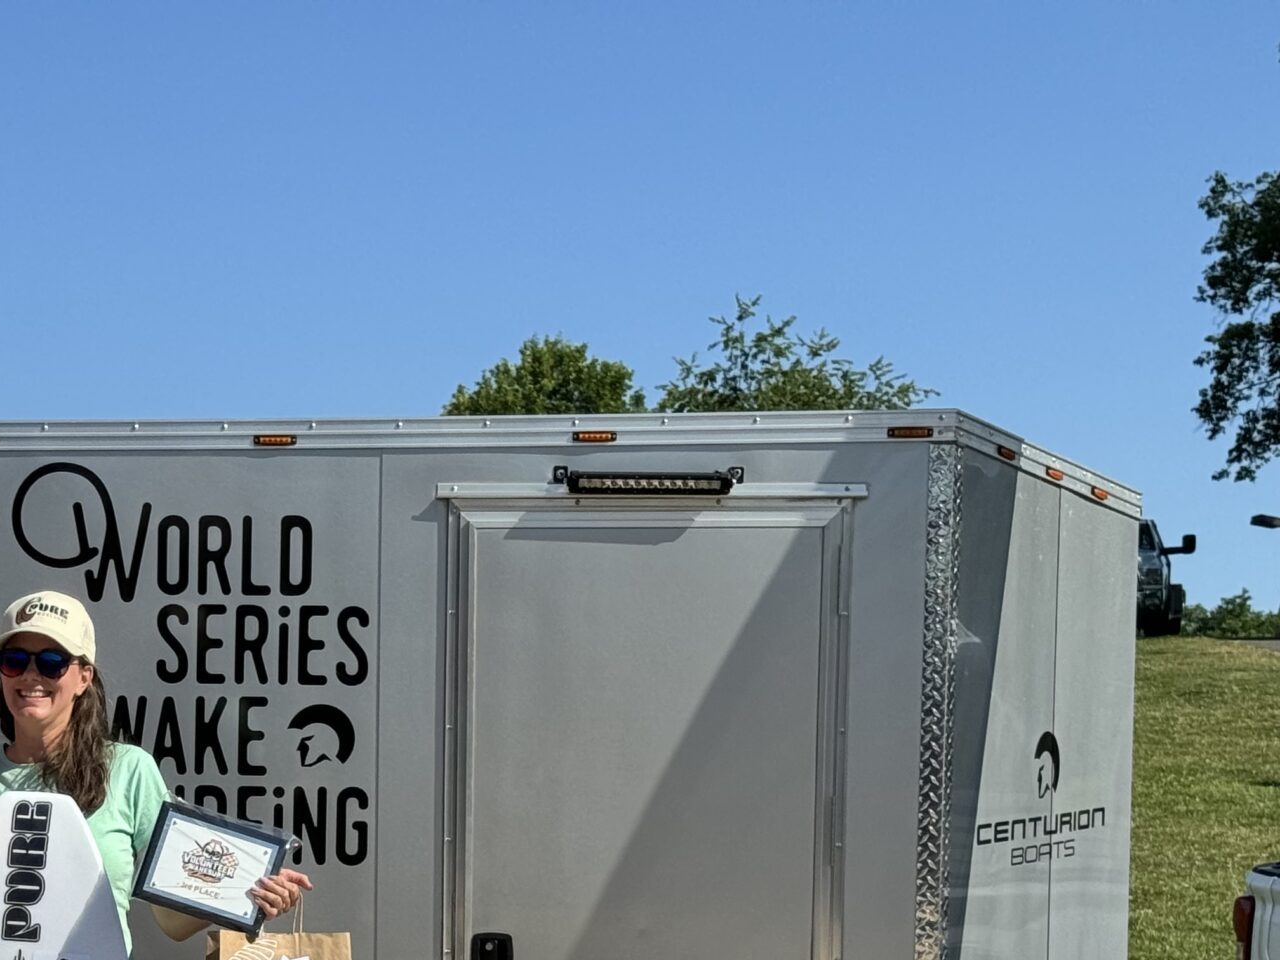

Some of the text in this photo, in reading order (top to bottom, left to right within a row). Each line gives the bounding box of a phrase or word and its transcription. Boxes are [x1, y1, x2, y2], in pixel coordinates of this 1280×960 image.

[12, 462, 313, 602] WORLD
[977, 807, 1106, 846] CENTURION
[182, 850, 237, 878] VOLUNTEER
[1011, 839, 1076, 866] BOATS
[1, 800, 53, 943] PURE
[193, 885, 219, 899] PLACE
